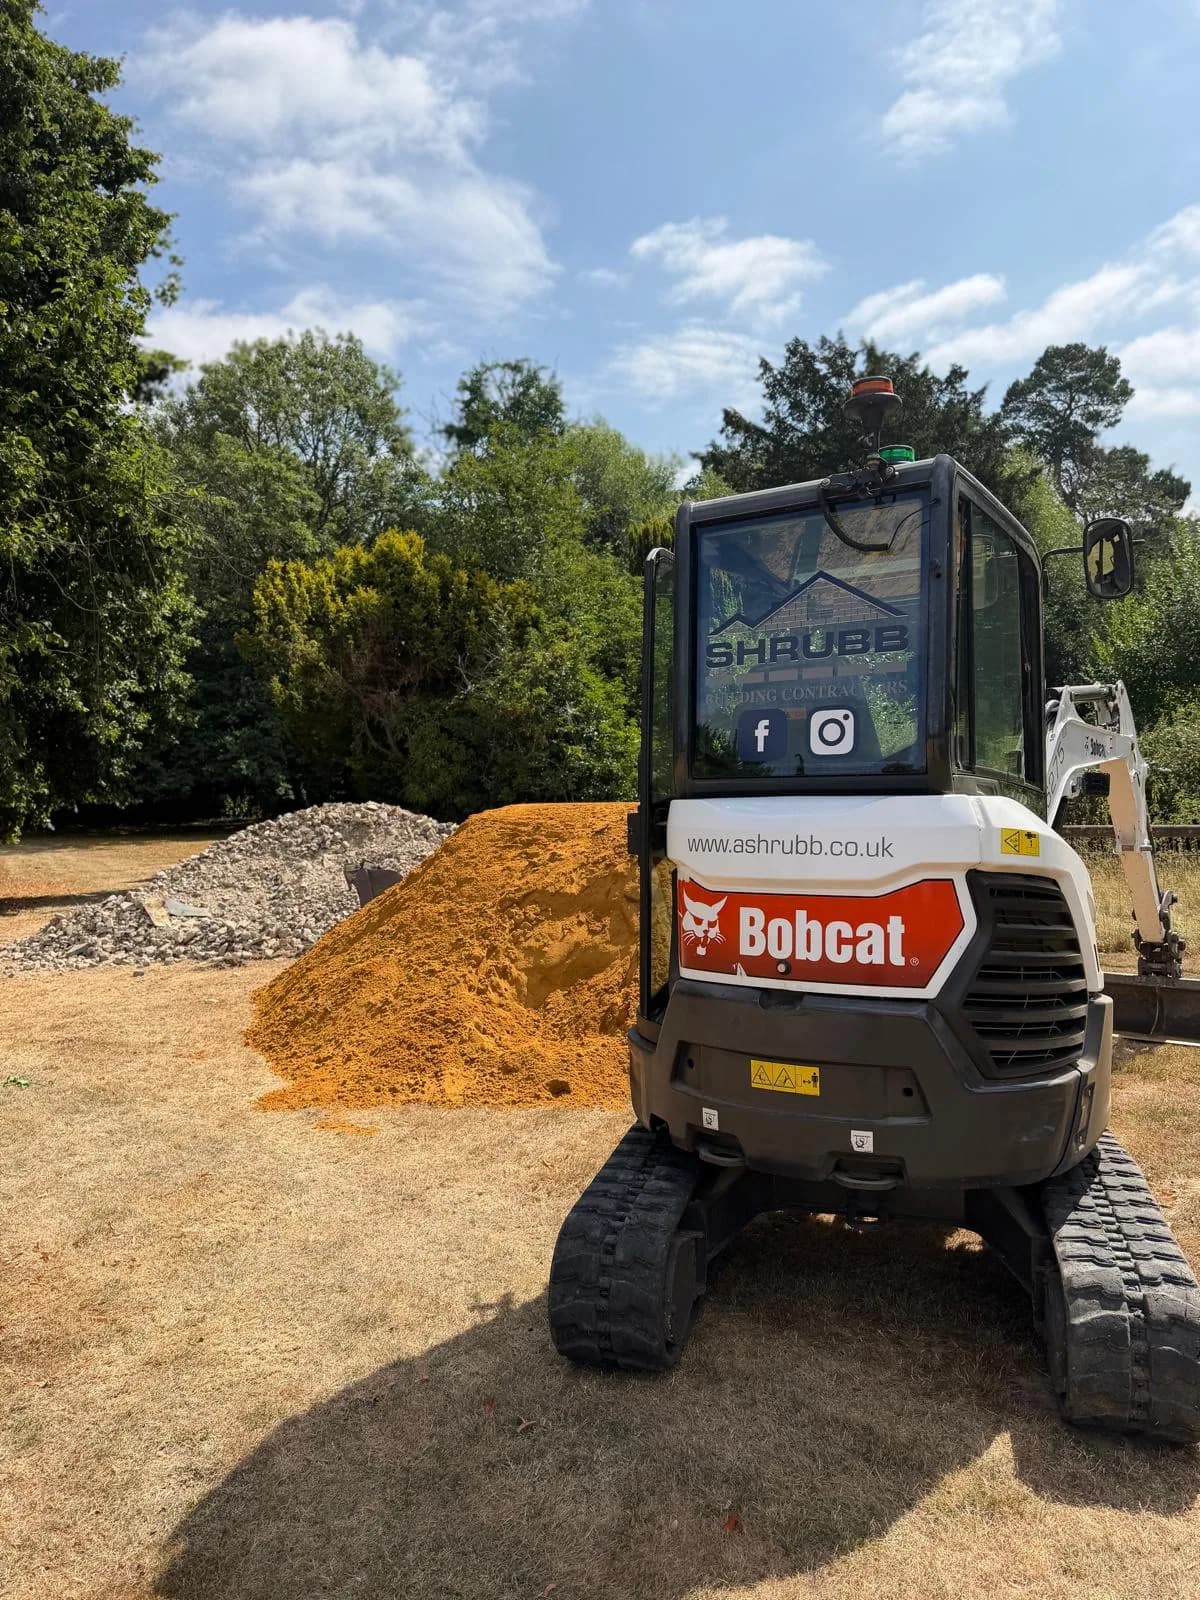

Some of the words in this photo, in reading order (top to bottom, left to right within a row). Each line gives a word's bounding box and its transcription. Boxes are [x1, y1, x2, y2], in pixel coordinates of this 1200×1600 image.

[706, 625, 909, 669] SHRUBB
[687, 834, 894, 858] www.ashrubb.co.uk
[739, 906, 905, 966] Bobcat
